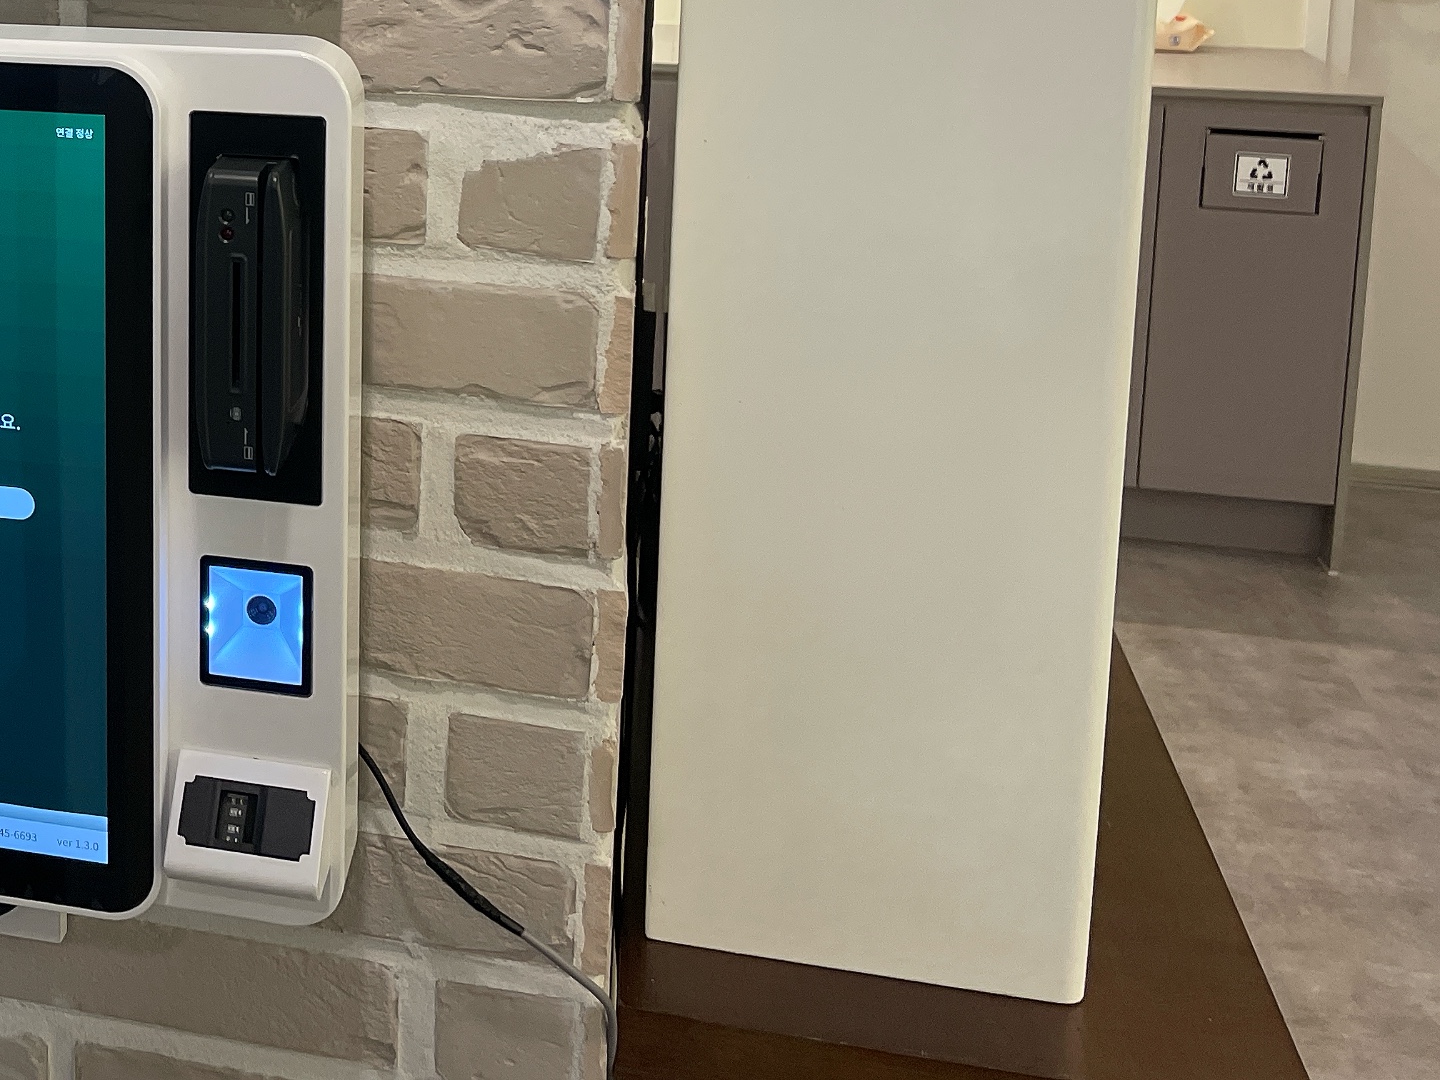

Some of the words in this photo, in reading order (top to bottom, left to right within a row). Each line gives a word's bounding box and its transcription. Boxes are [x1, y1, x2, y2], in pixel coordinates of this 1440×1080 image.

[56, 127, 74, 139] 연결
[76, 129, 93, 139] 정상
[56, 838, 72, 847] ver
[75, 839, 100, 852] 1.3.0
